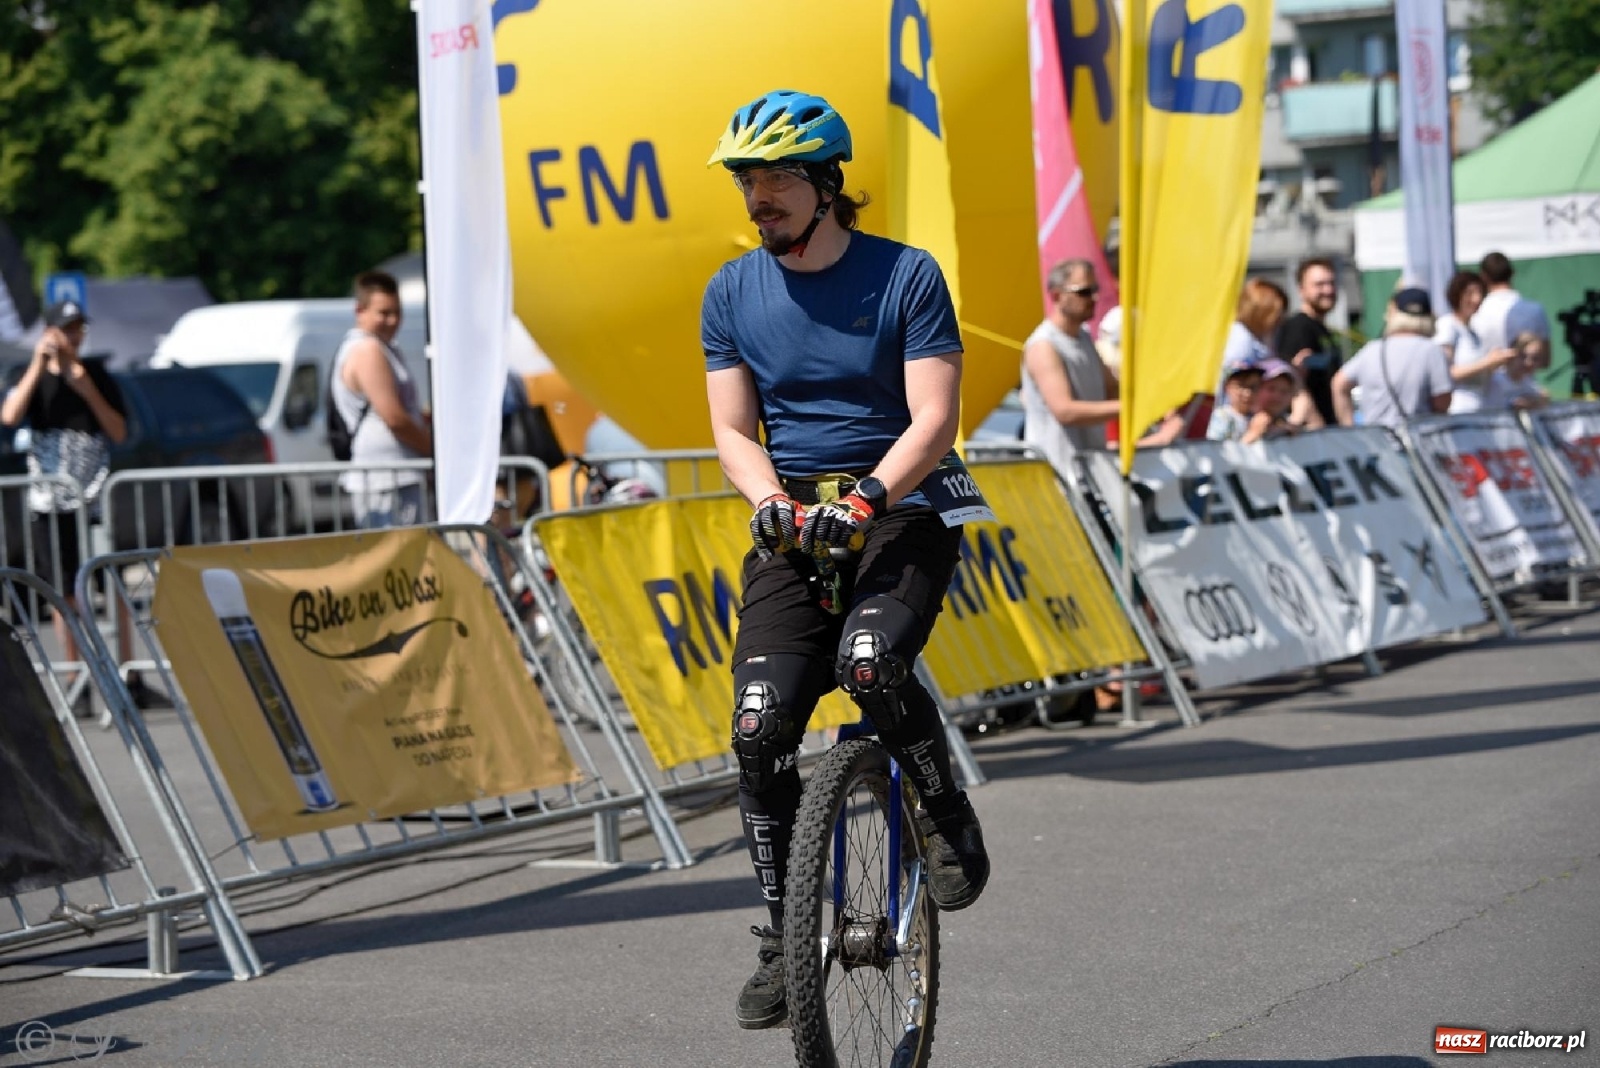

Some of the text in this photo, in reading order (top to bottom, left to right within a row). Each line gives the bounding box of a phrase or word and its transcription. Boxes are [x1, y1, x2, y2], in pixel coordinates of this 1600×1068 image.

[528, 140, 671, 229] FM
[290, 585, 356, 642] Bike
[384, 567, 444, 612] Wax
[643, 567, 743, 678] RM
[1046, 595, 1089, 633] FM
